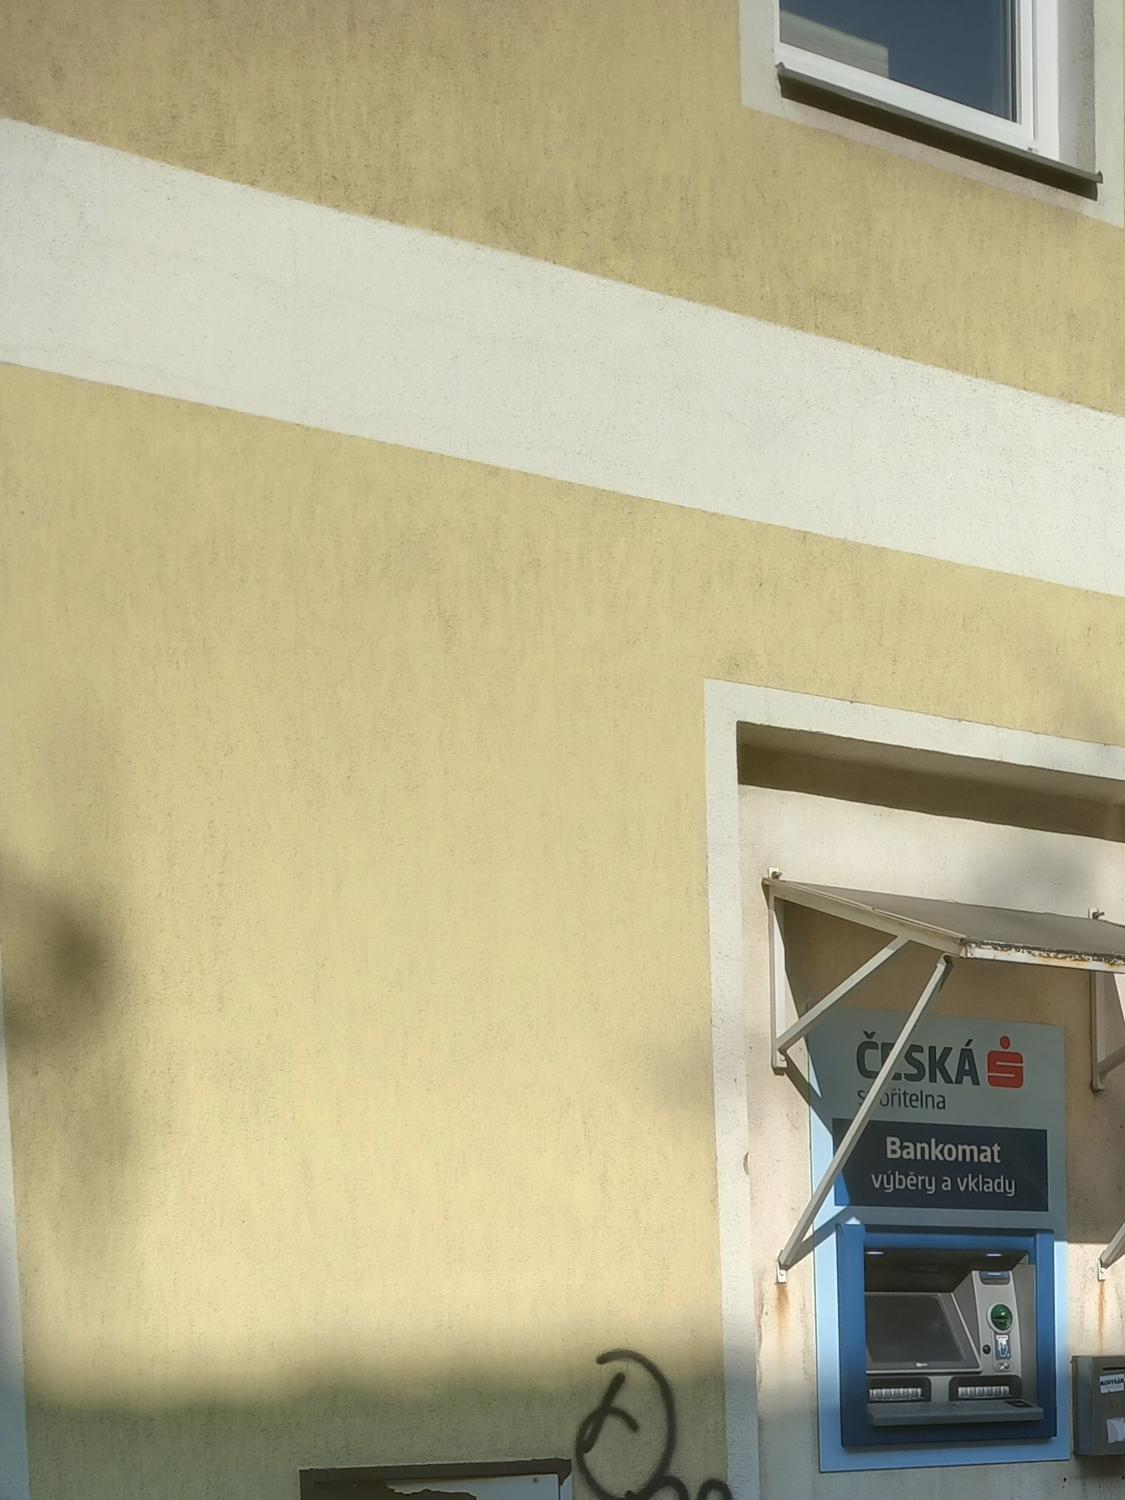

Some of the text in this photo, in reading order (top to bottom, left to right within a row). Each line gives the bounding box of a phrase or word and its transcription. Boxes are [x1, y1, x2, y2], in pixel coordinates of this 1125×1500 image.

[857, 1088, 946, 1110] sořitelna
[886, 1136, 1001, 1163] Bankomat
[871, 1170, 1016, 1197] výběry a vklady
